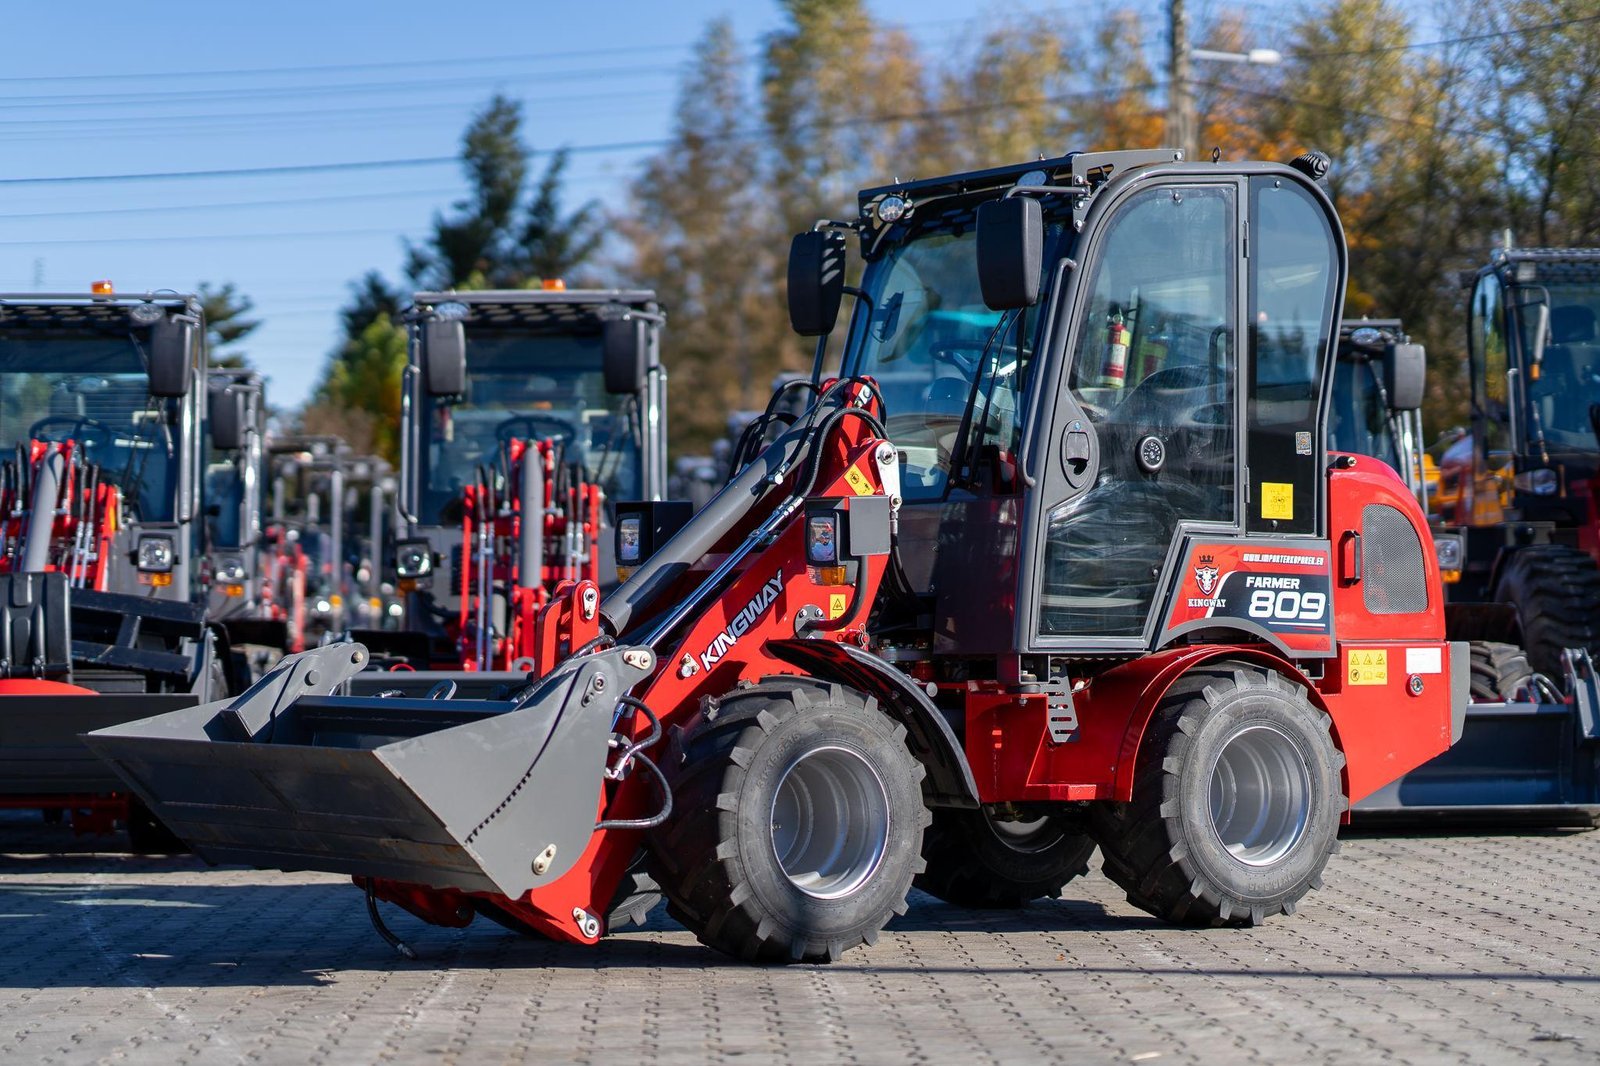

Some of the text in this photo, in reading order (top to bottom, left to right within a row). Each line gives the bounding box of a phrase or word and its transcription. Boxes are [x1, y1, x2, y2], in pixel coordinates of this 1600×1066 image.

[1246, 576, 1300, 589] FARMER
[1188, 598, 1226, 608] KINGWAY
[1248, 590, 1326, 620] 809
[700, 569, 784, 671] KINGWAY
